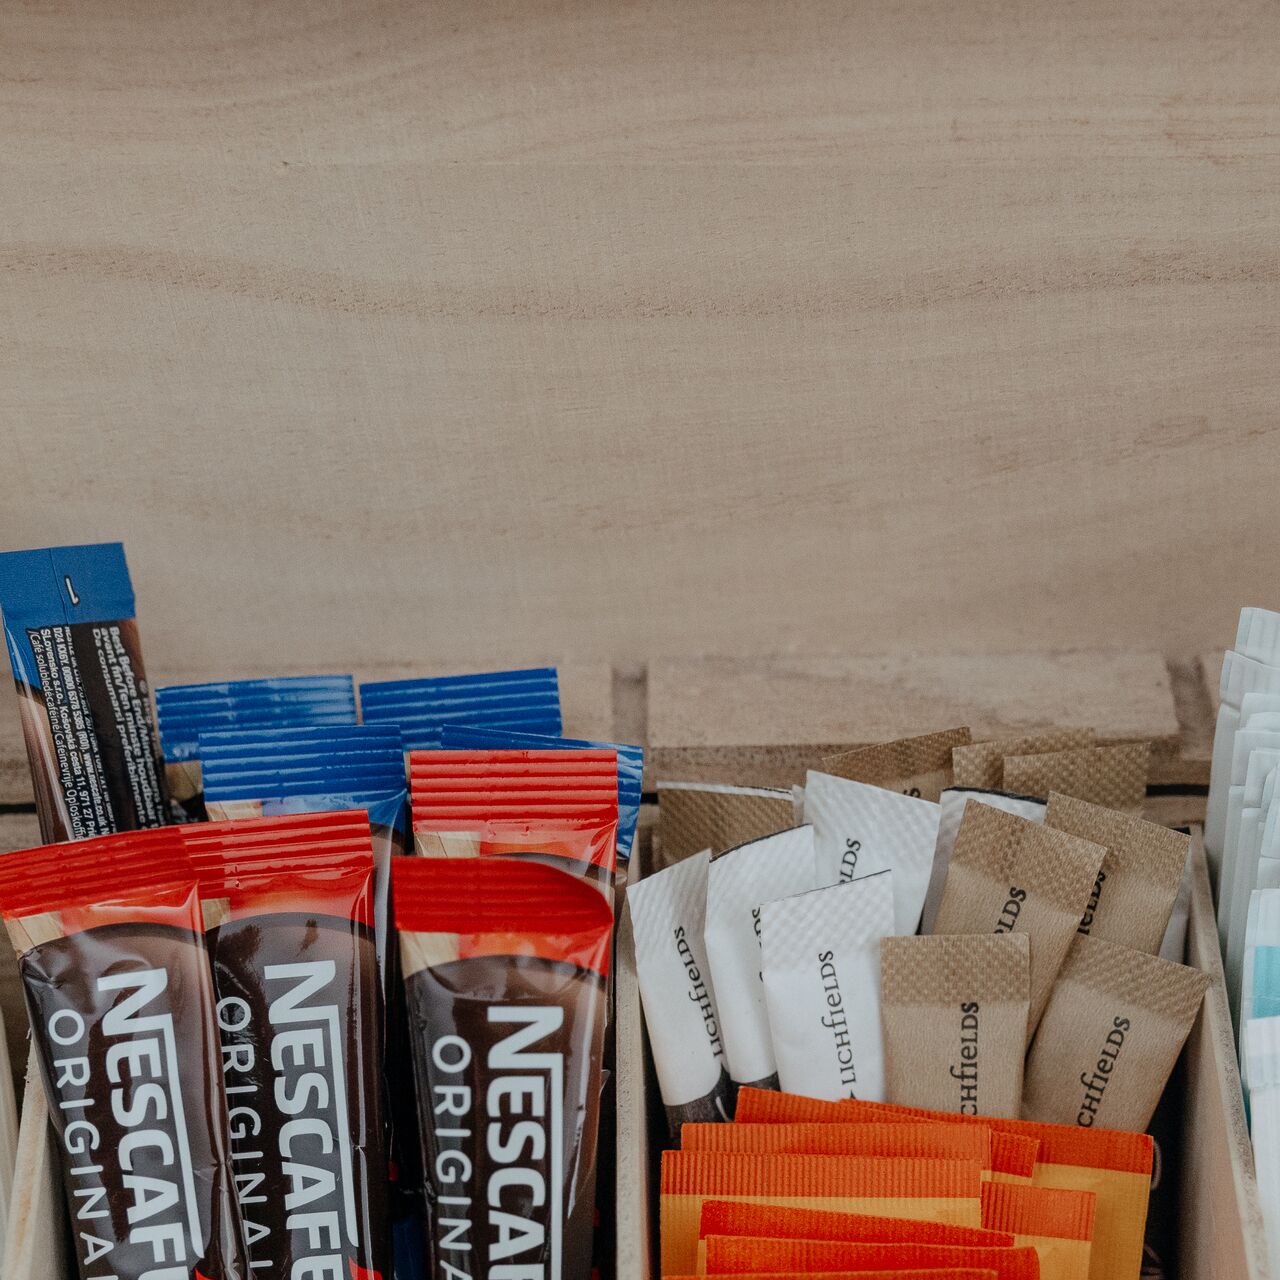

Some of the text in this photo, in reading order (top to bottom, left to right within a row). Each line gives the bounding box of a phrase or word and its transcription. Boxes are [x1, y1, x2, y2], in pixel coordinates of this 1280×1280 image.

[91, 627, 103, 647] Da
[98, 626, 117, 664] avant
[108, 625, 126, 655] Best
[117, 654, 140, 698] Before
[69, 750, 82, 775] cesta
[78, 789, 90, 806] 971
[82, 807, 93, 819] 27
